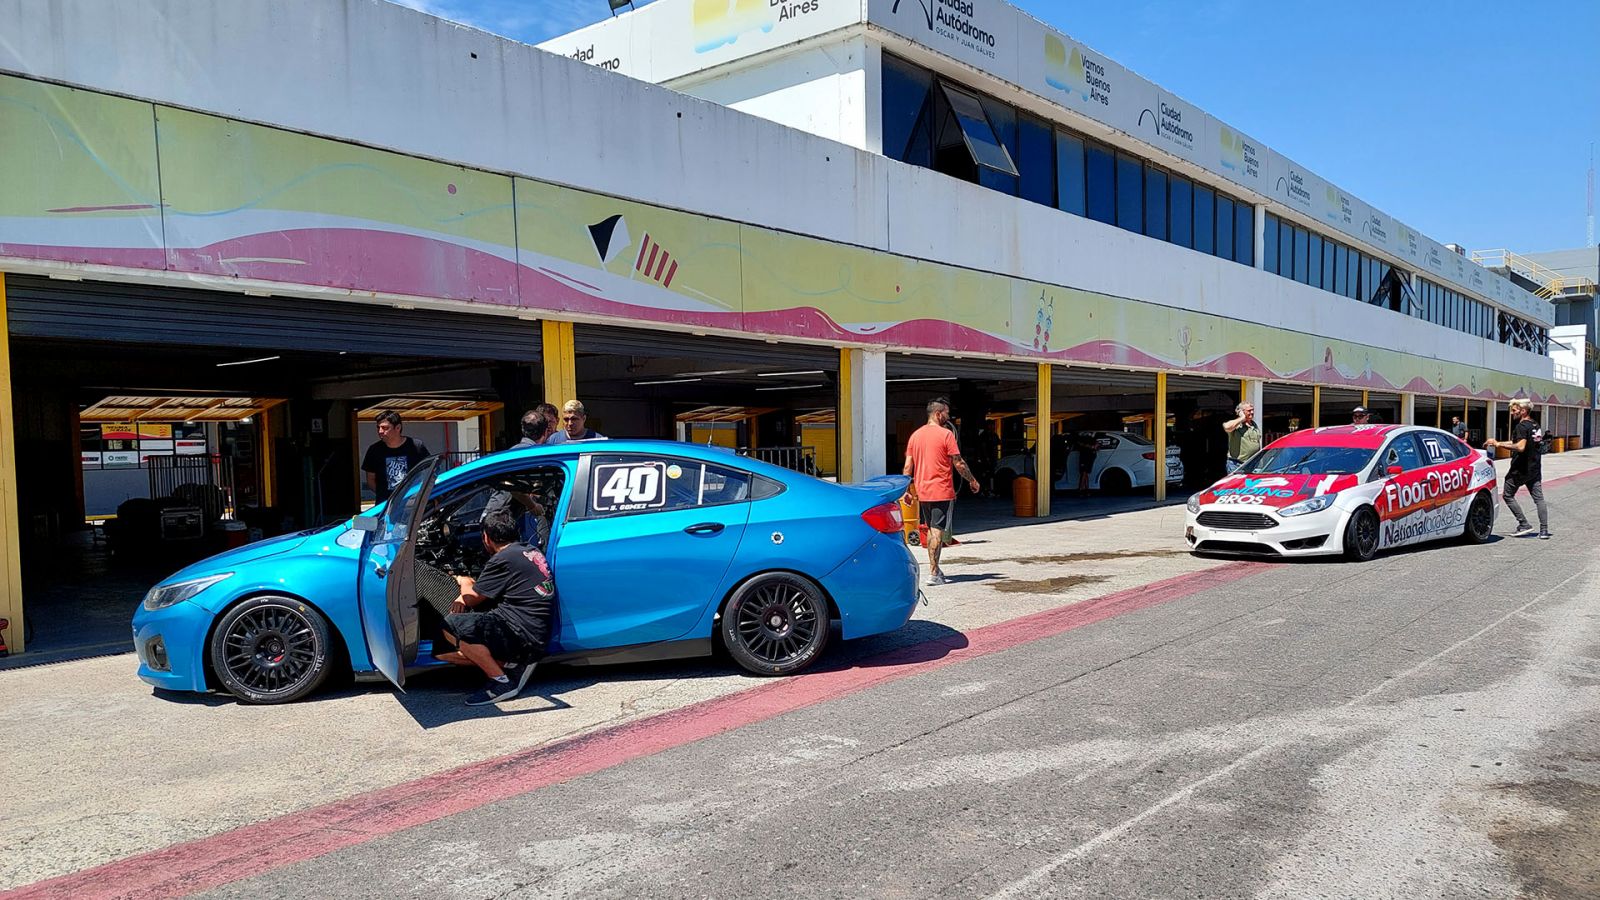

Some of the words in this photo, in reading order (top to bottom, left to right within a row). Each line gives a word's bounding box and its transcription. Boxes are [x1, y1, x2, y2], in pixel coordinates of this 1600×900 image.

[779, 0, 819, 22] Aires
[938, 0, 974, 18] iudad
[936, 7, 995, 47] Autódromo
[936, 27, 954, 40] OSCAR
[961, 40, 974, 50] JUAN
[1081, 54, 1105, 77] Vamos
[1085, 70, 1111, 94] Buenos
[1090, 87, 1109, 106] Aires
[1160, 102, 1182, 123] Ciudad
[1160, 117, 1193, 143] Autódromo
[601, 467, 659, 504] 40
[1212, 486, 1295, 498] VENDING
[1215, 494, 1267, 505] BROS
